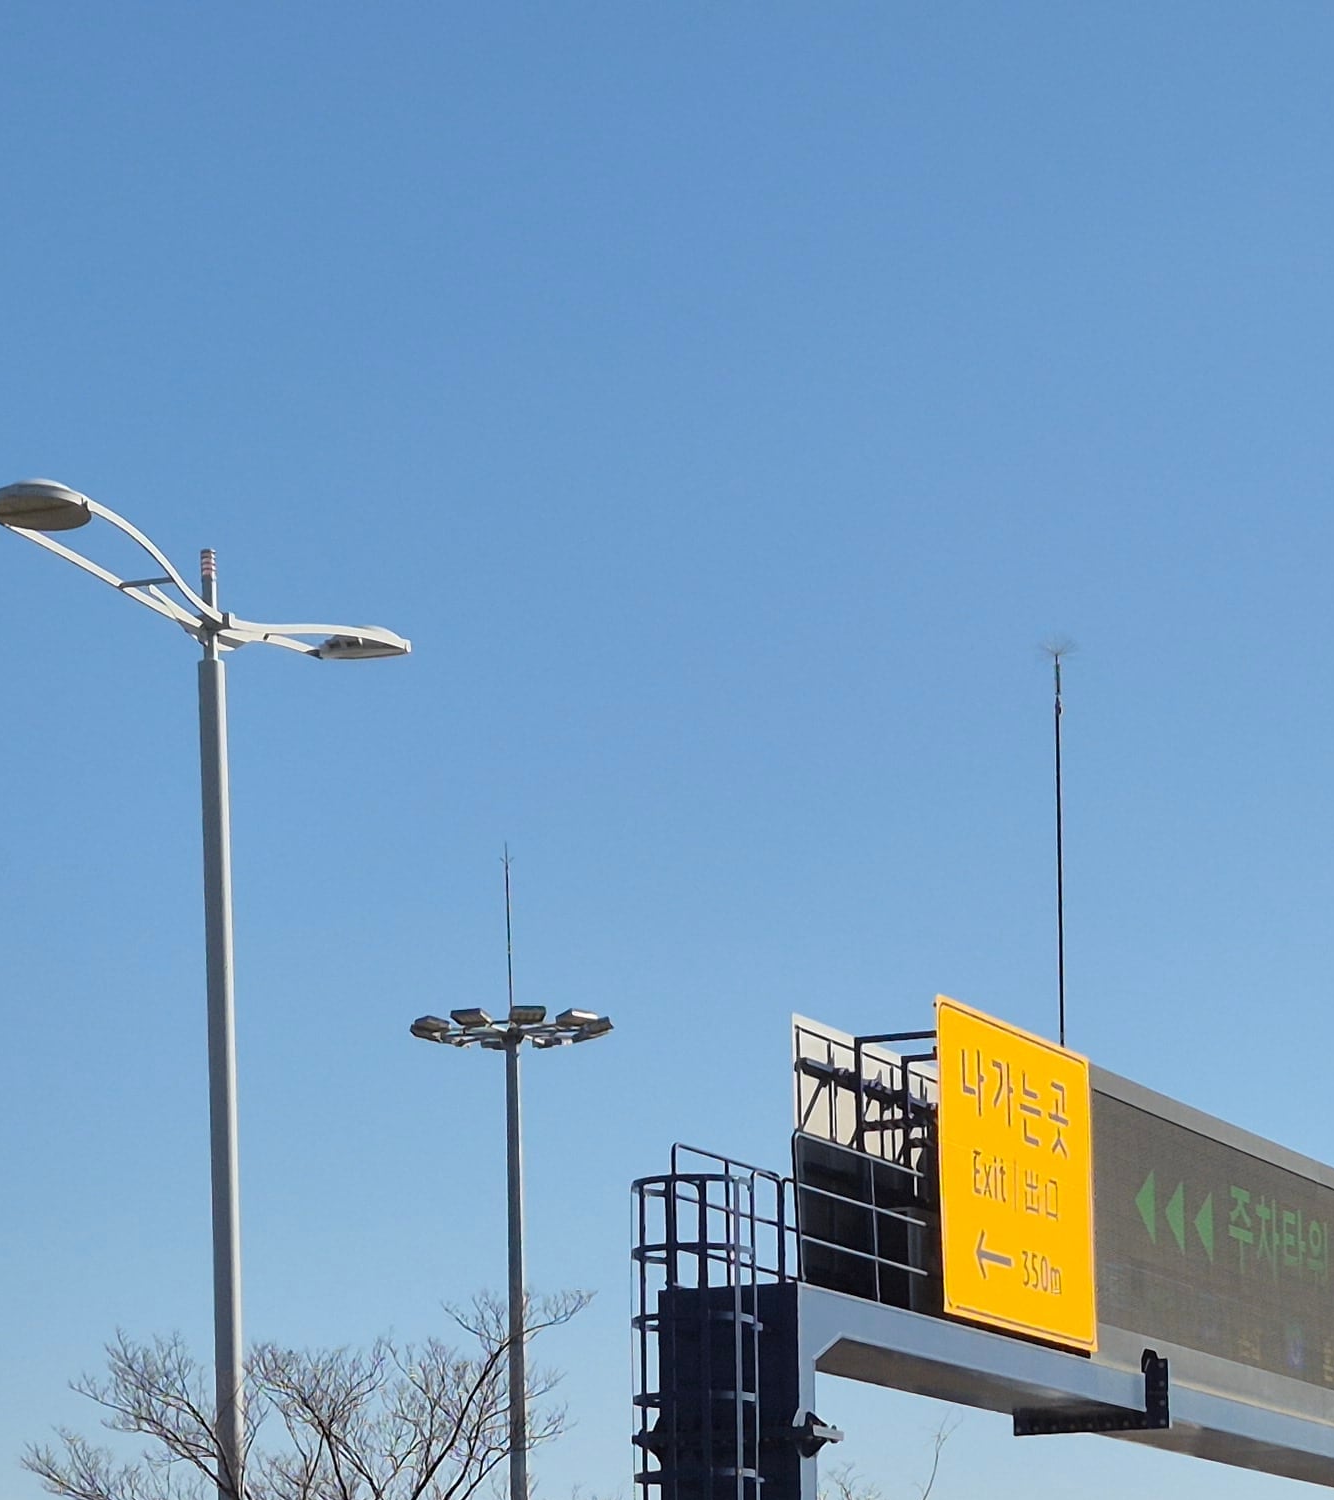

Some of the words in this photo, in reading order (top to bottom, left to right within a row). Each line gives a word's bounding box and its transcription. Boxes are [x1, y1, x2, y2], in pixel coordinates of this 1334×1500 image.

[972, 1150, 1007, 1203] Exit
[1024, 1168, 1060, 1222] 出口
[1021, 1250, 1063, 1296] 350m
